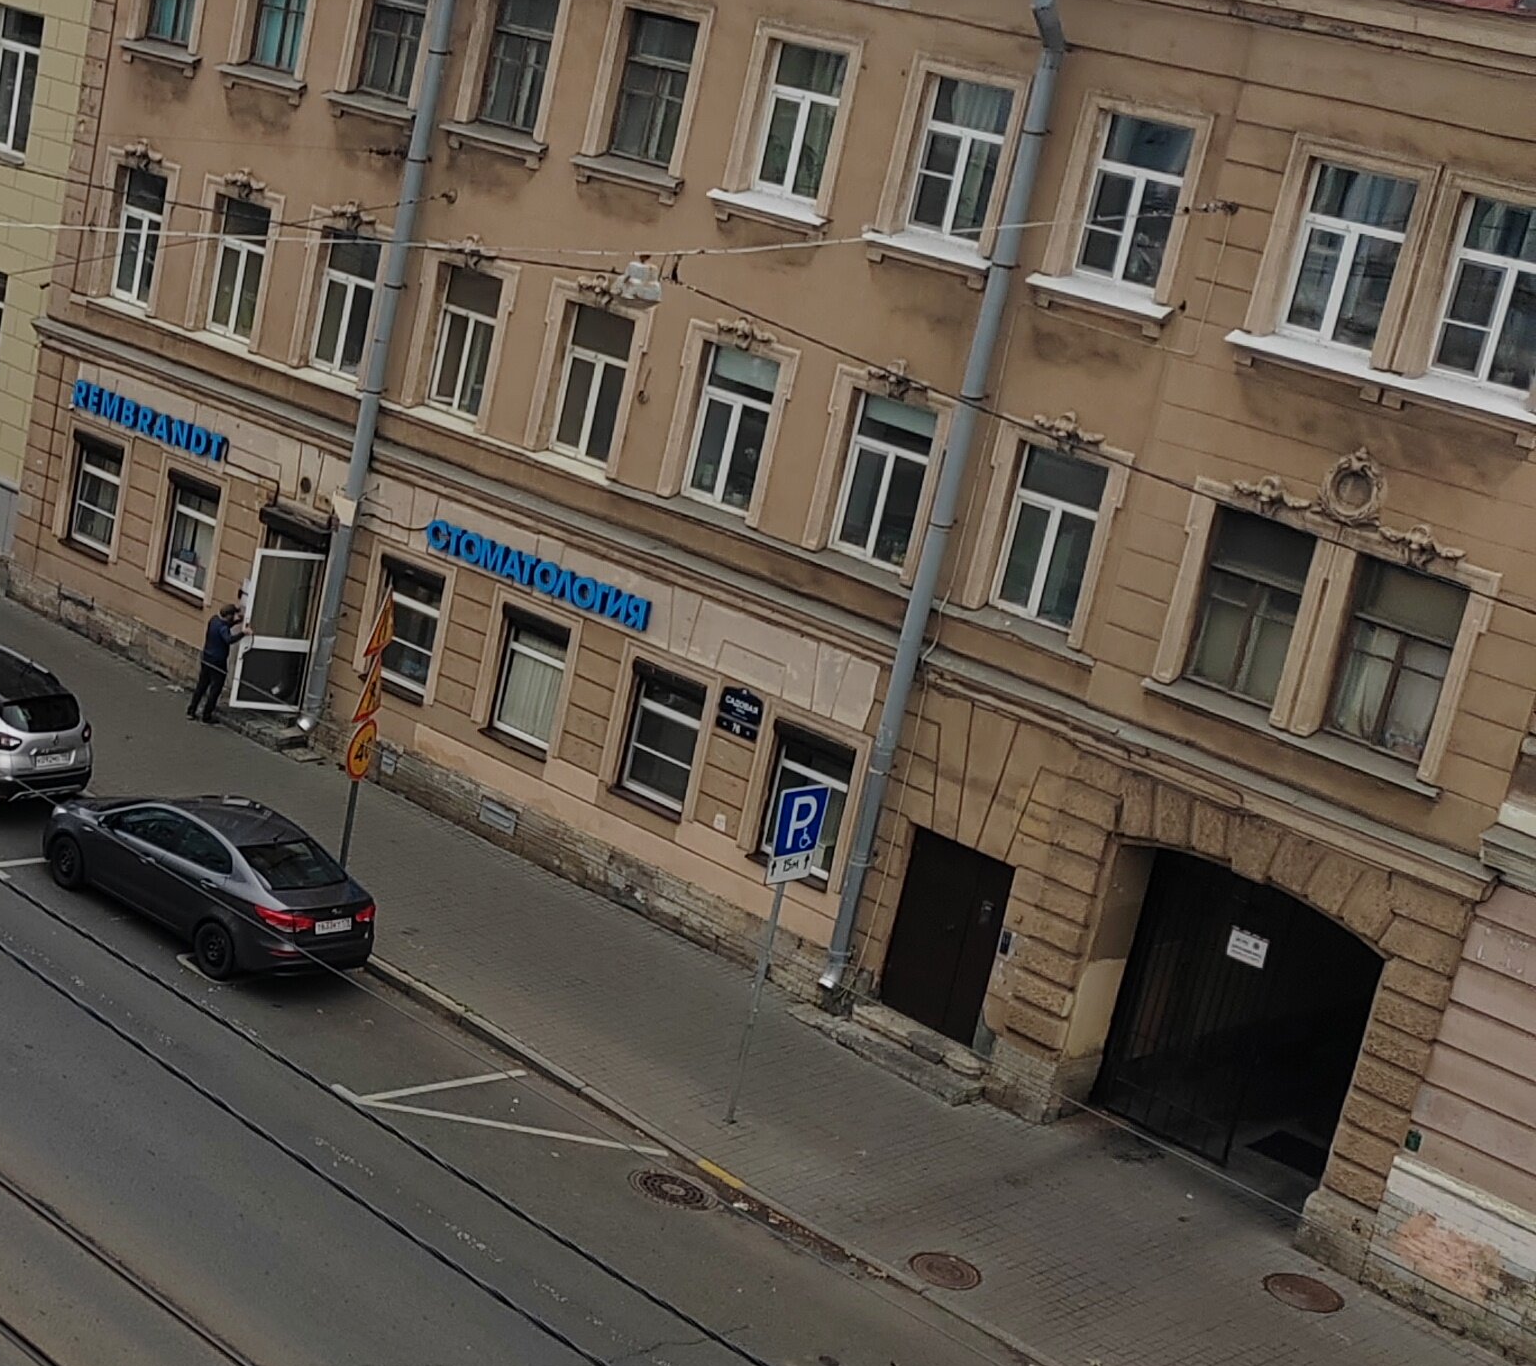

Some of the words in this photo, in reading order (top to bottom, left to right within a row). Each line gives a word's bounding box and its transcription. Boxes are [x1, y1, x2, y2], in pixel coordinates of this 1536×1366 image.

[73, 379, 225, 462] REMBRANDT
[426, 519, 652, 633] СТОМАТОЛОГИЯ
[785, 795, 818, 849] P
